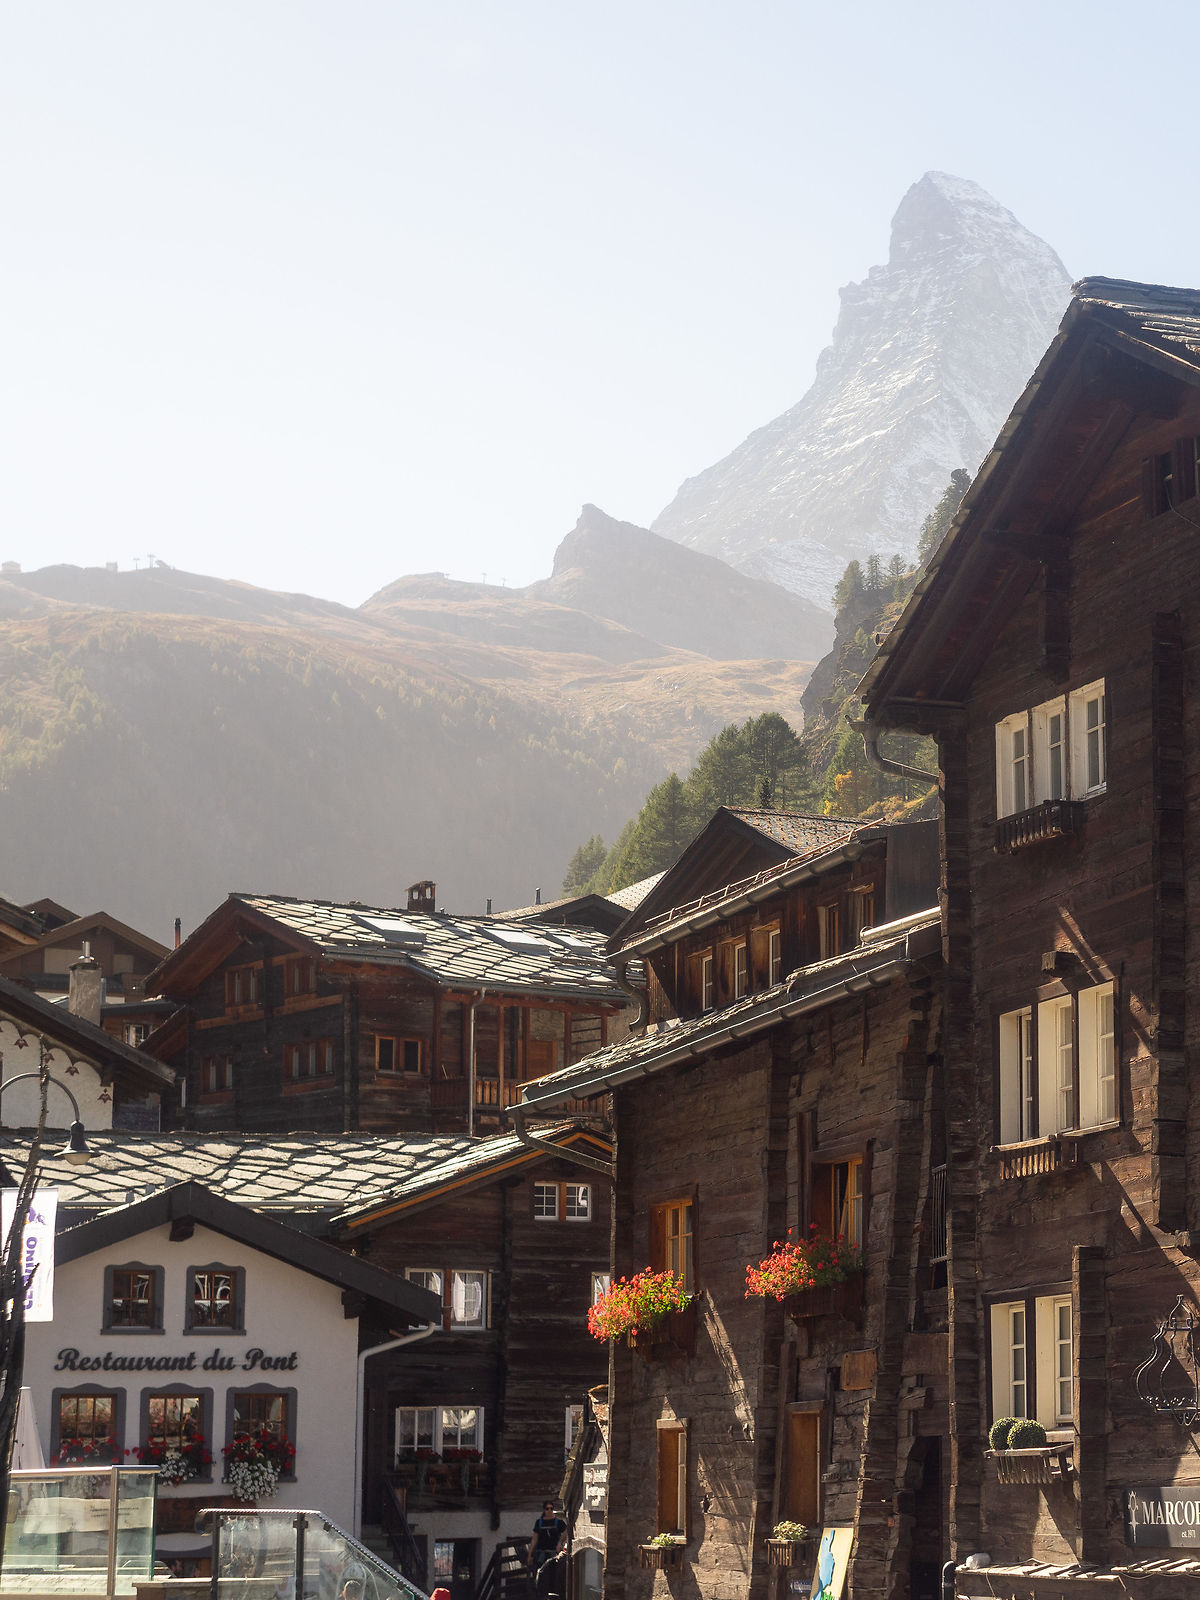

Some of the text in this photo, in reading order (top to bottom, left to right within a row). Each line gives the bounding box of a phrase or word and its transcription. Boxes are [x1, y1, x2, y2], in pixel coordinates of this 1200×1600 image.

[53, 1348, 298, 1372] Restaurant du Pont
